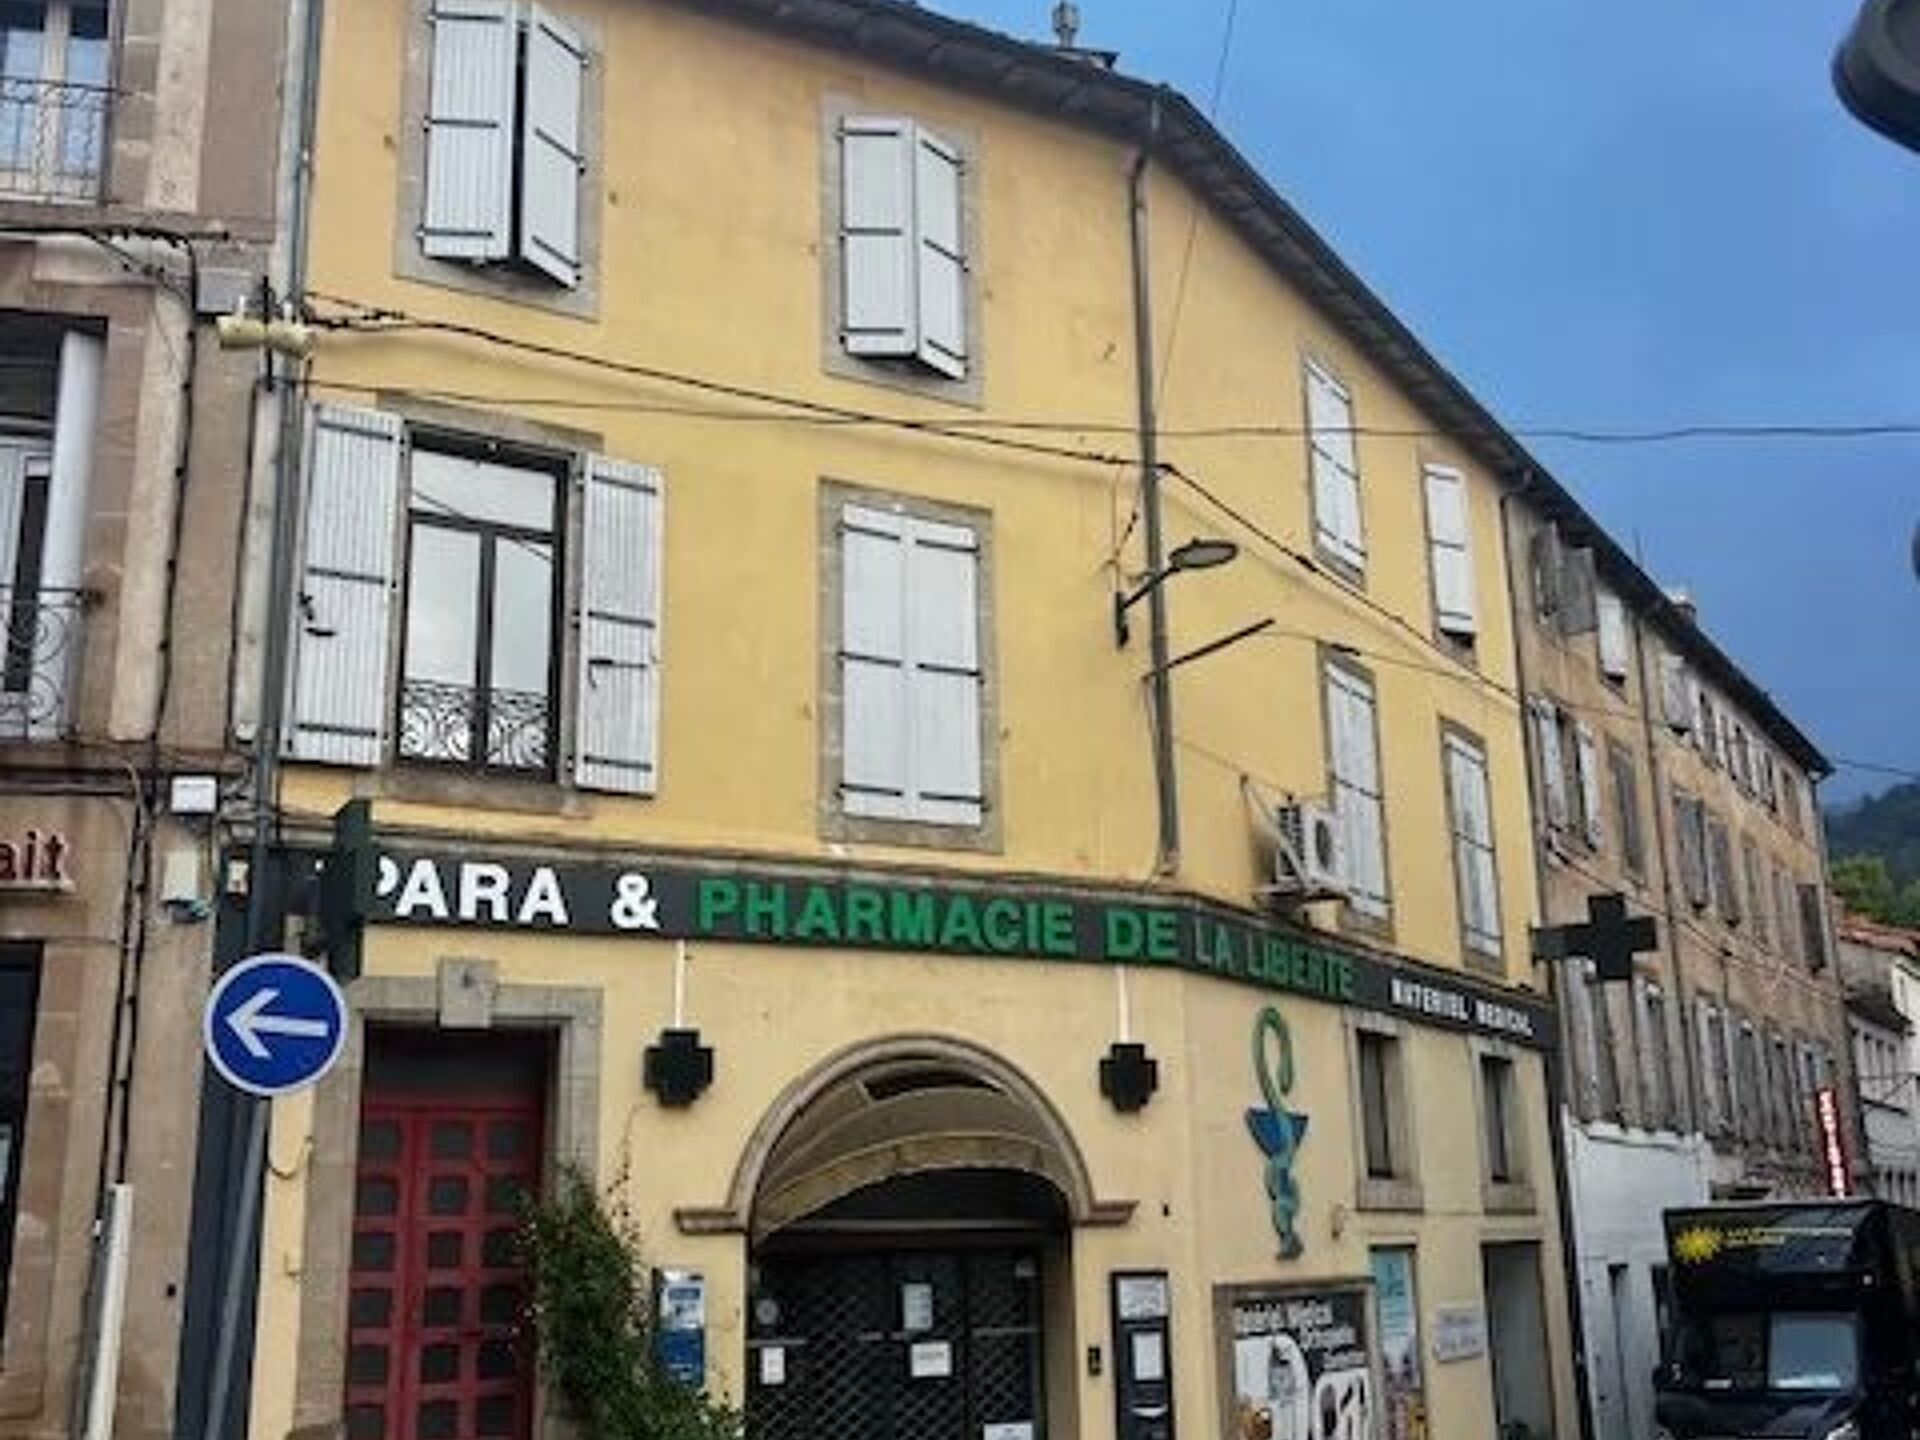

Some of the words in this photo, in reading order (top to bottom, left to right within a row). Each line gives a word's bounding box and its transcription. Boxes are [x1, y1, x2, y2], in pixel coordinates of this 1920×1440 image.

[611, 873, 660, 929] &
[697, 879, 1077, 955] PHARMACIE
[1105, 910, 1180, 960] DE
[1195, 916, 1233, 974] LA
